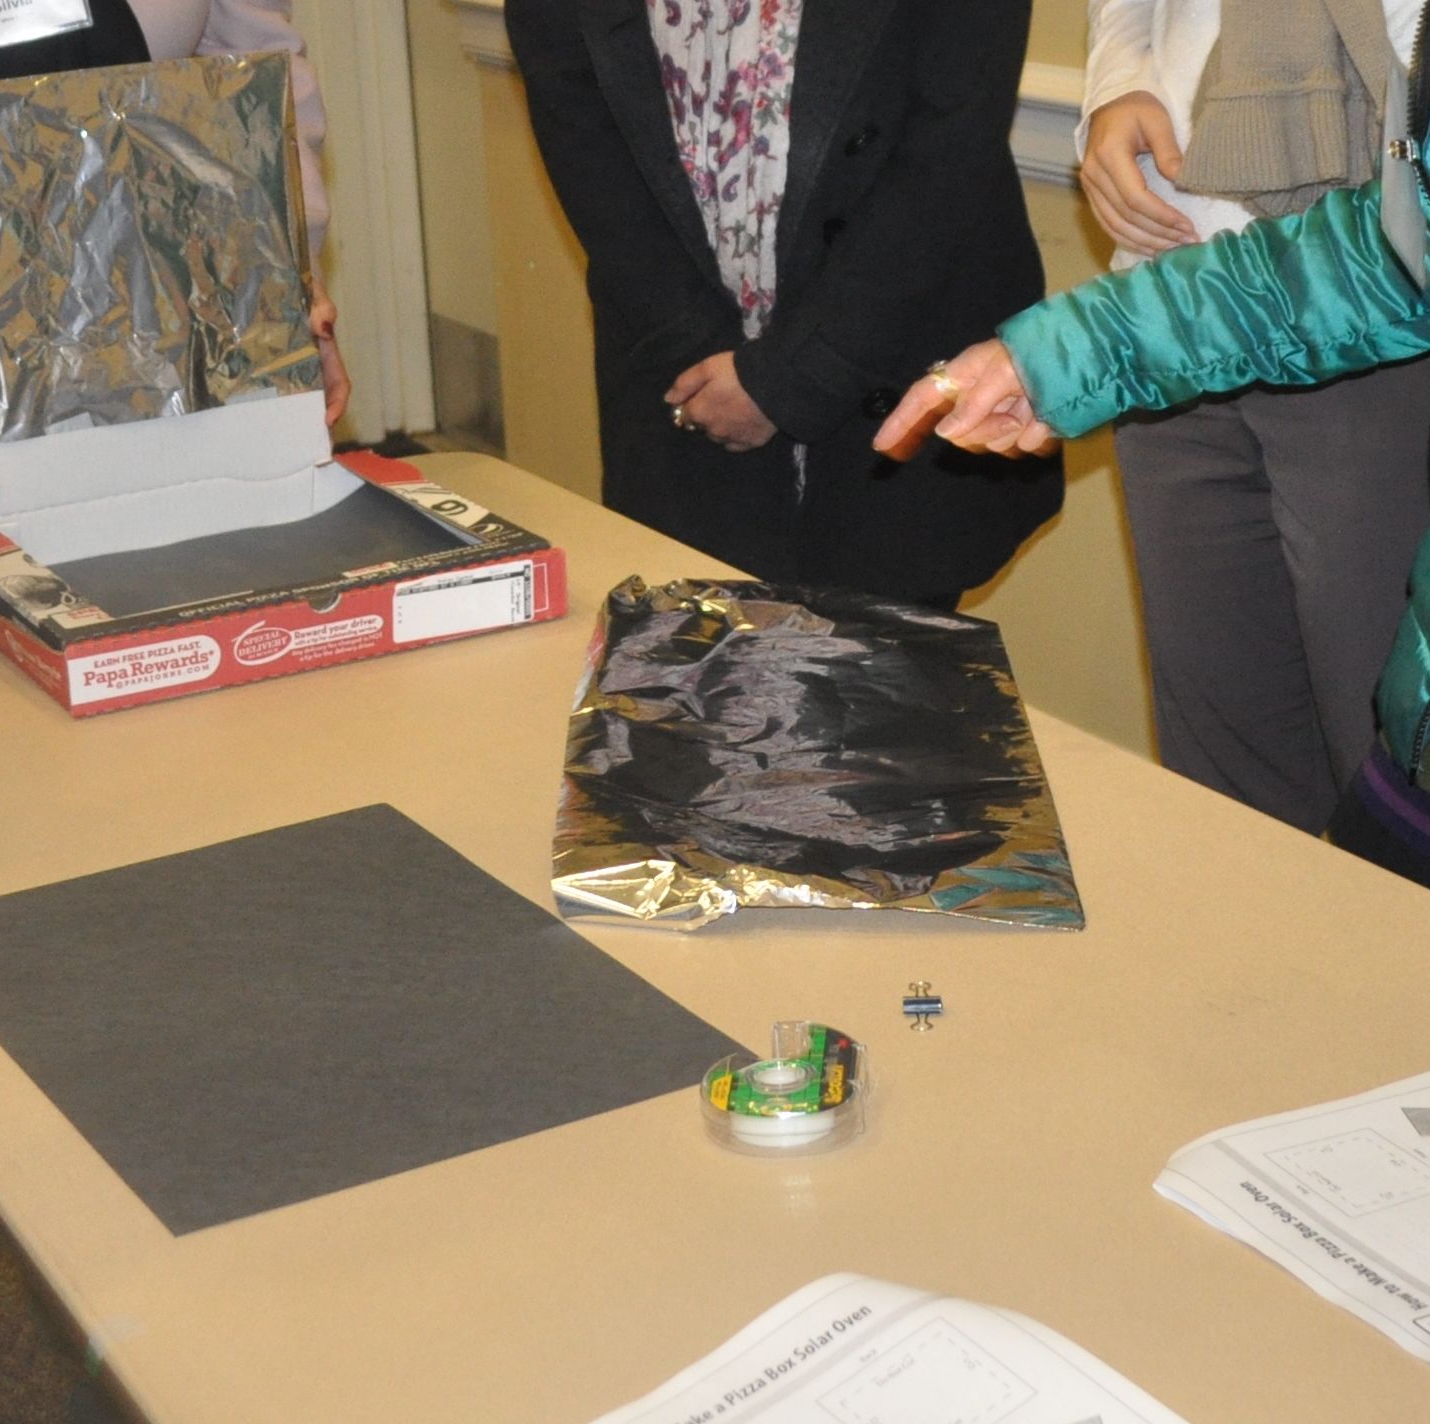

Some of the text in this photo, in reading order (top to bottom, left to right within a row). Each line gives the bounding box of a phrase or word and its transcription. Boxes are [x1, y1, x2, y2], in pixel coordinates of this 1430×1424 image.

[243, 631, 282, 646] SPECIAL
[294, 618, 377, 639] Reward your driver
[239, 636, 288, 656] DELIVERY
[94, 657, 120, 668] EARN
[123, 652, 146, 663] FREE
[148, 646, 174, 658] PIZZA
[83, 668, 127, 688] Papa
[1239, 1180, 1429, 1311] How to Make a Pizza Box Solar Oven
[715, 1403, 726, 1414] a
[723, 1378, 766, 1406] Pizza
[764, 1357, 796, 1381] Box
[793, 1329, 834, 1362] Solar
[832, 1304, 873, 1334] Oven
